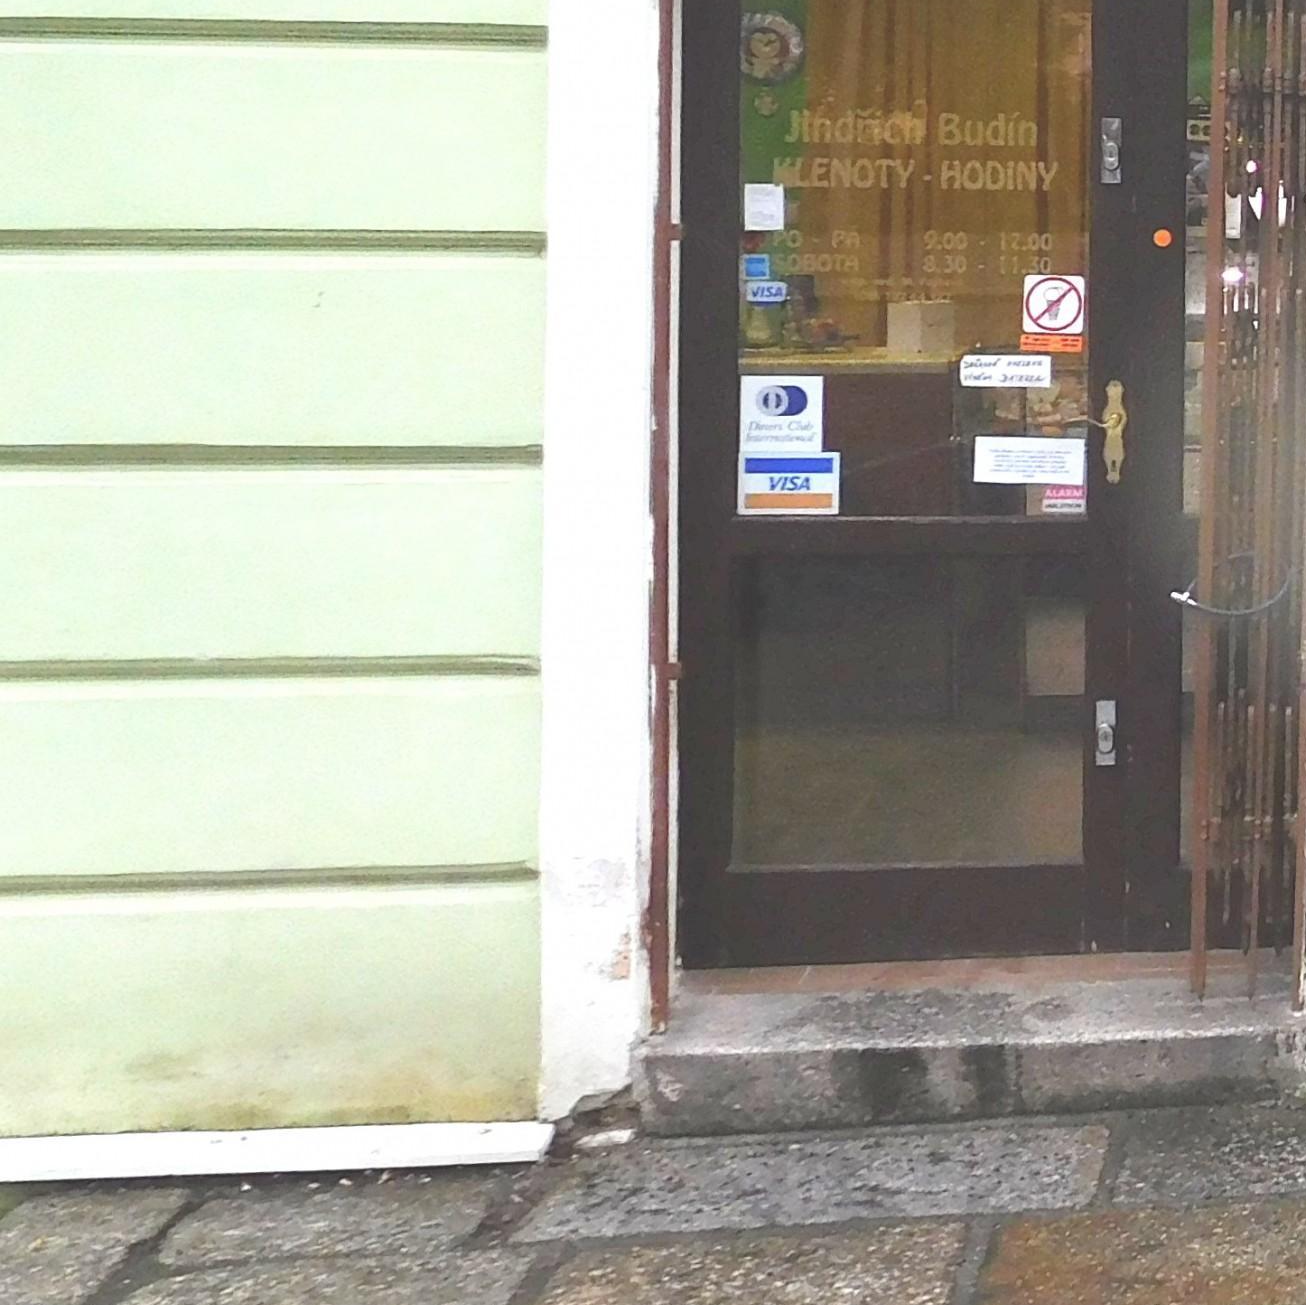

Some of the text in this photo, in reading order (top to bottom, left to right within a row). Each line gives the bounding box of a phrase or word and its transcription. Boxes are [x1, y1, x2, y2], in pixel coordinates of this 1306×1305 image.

[937, 111, 1039, 147] Budín
[773, 156, 917, 189] KLENOTY
[923, 229, 969, 251] 9.00
[774, 253, 860, 273] SOBOTA
[921, 253, 968, 274] 8.30
[751, 285, 784, 299] VISA
[768, 476, 812, 492] VISA
